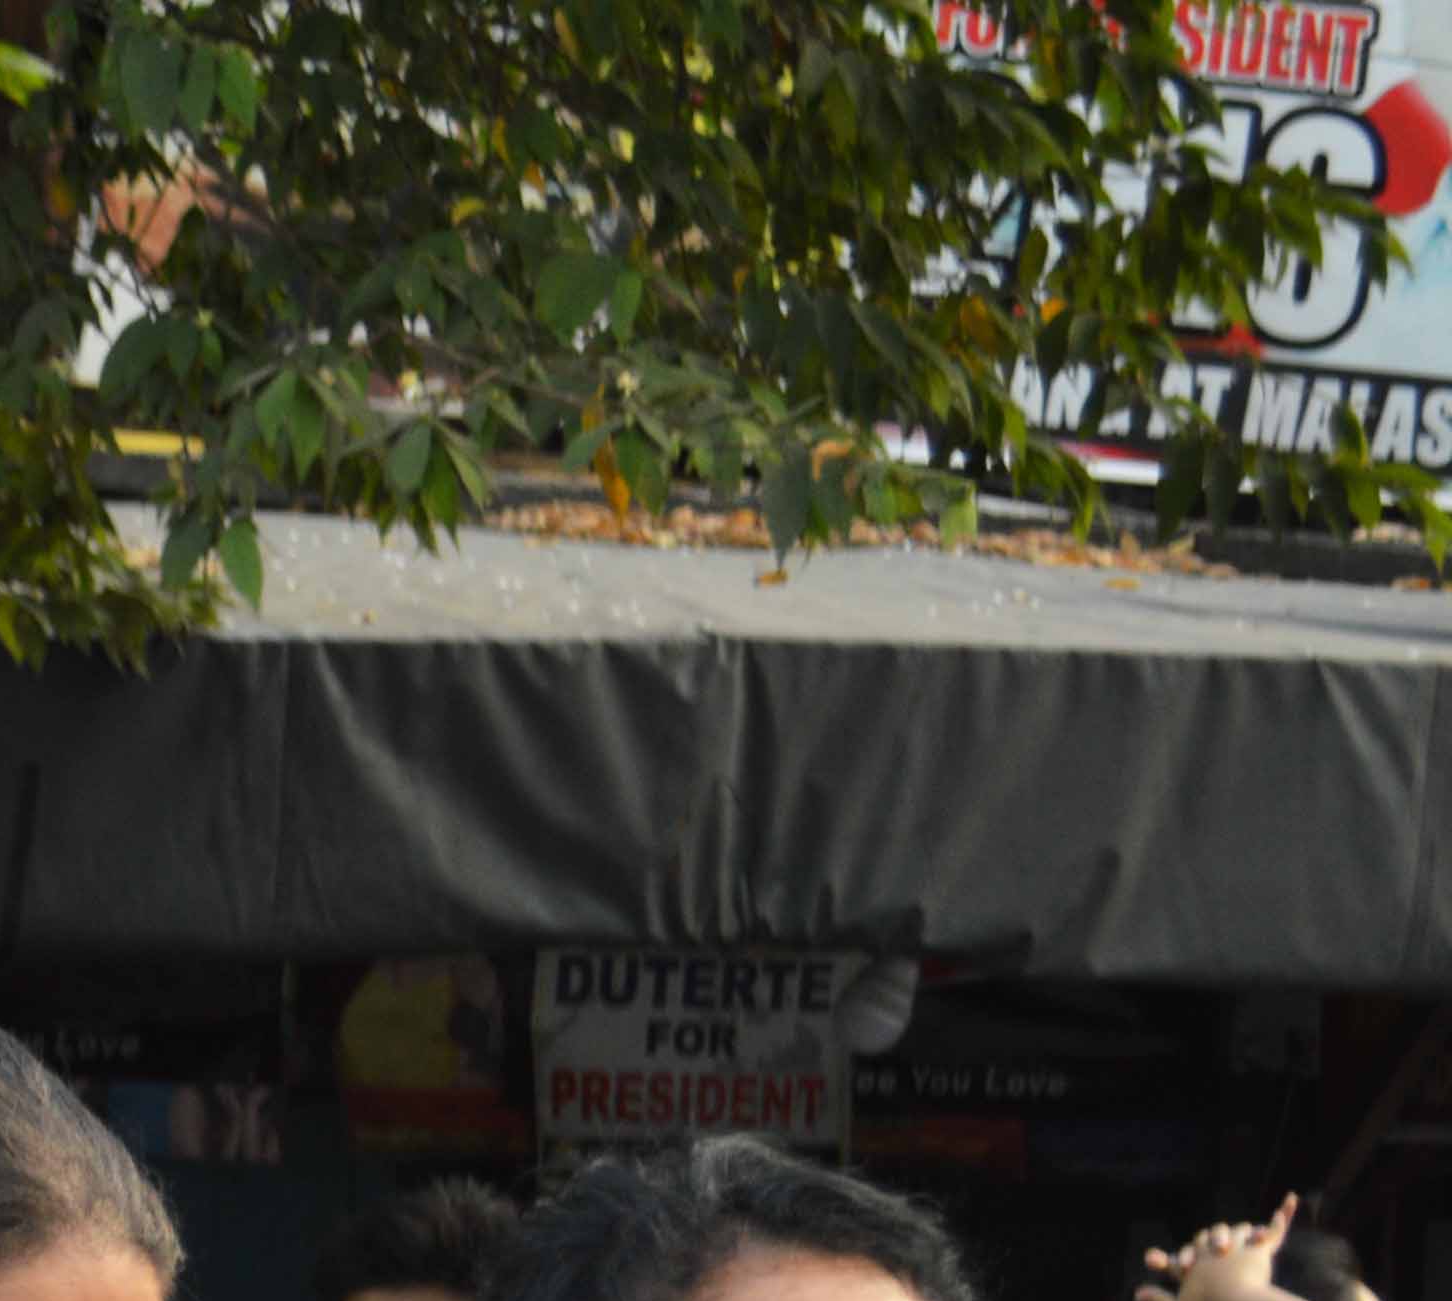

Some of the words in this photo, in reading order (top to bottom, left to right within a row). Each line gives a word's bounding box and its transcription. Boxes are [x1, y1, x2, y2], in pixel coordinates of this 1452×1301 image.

[555, 955, 832, 1013] DUTERTE
[646, 1021, 736, 1059] FOR
[550, 1069, 828, 1128] PRESIDENT
[911, 1061, 972, 1097] You
[984, 1061, 1069, 1098] Love
